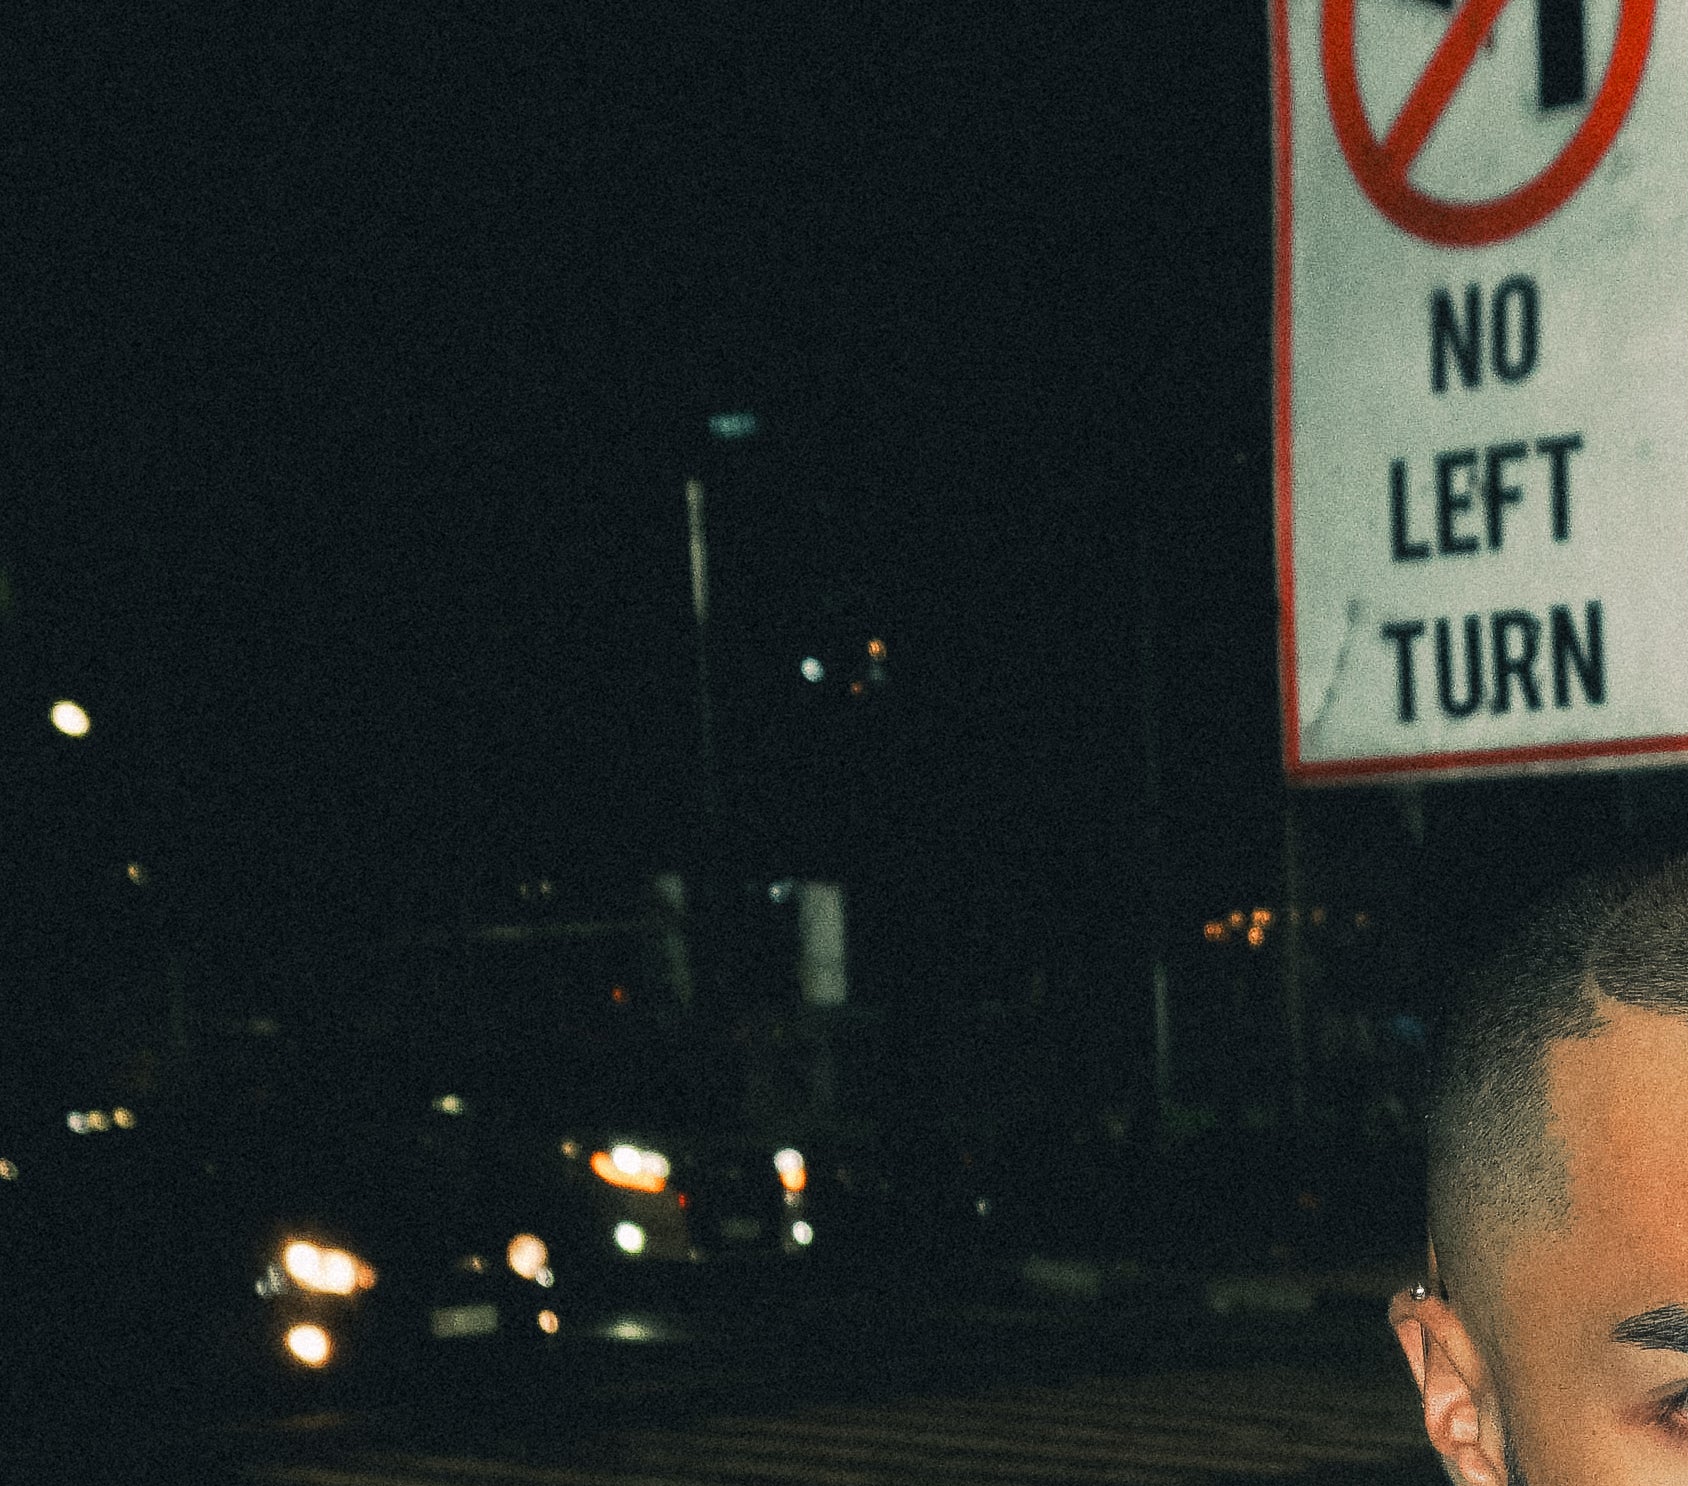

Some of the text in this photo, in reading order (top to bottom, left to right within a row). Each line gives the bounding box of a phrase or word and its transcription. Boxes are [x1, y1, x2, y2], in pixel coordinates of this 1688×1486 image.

[1429, 272, 1540, 394] NO
[1389, 432, 1582, 562] LEFT
[1382, 600, 1606, 724] TURN
